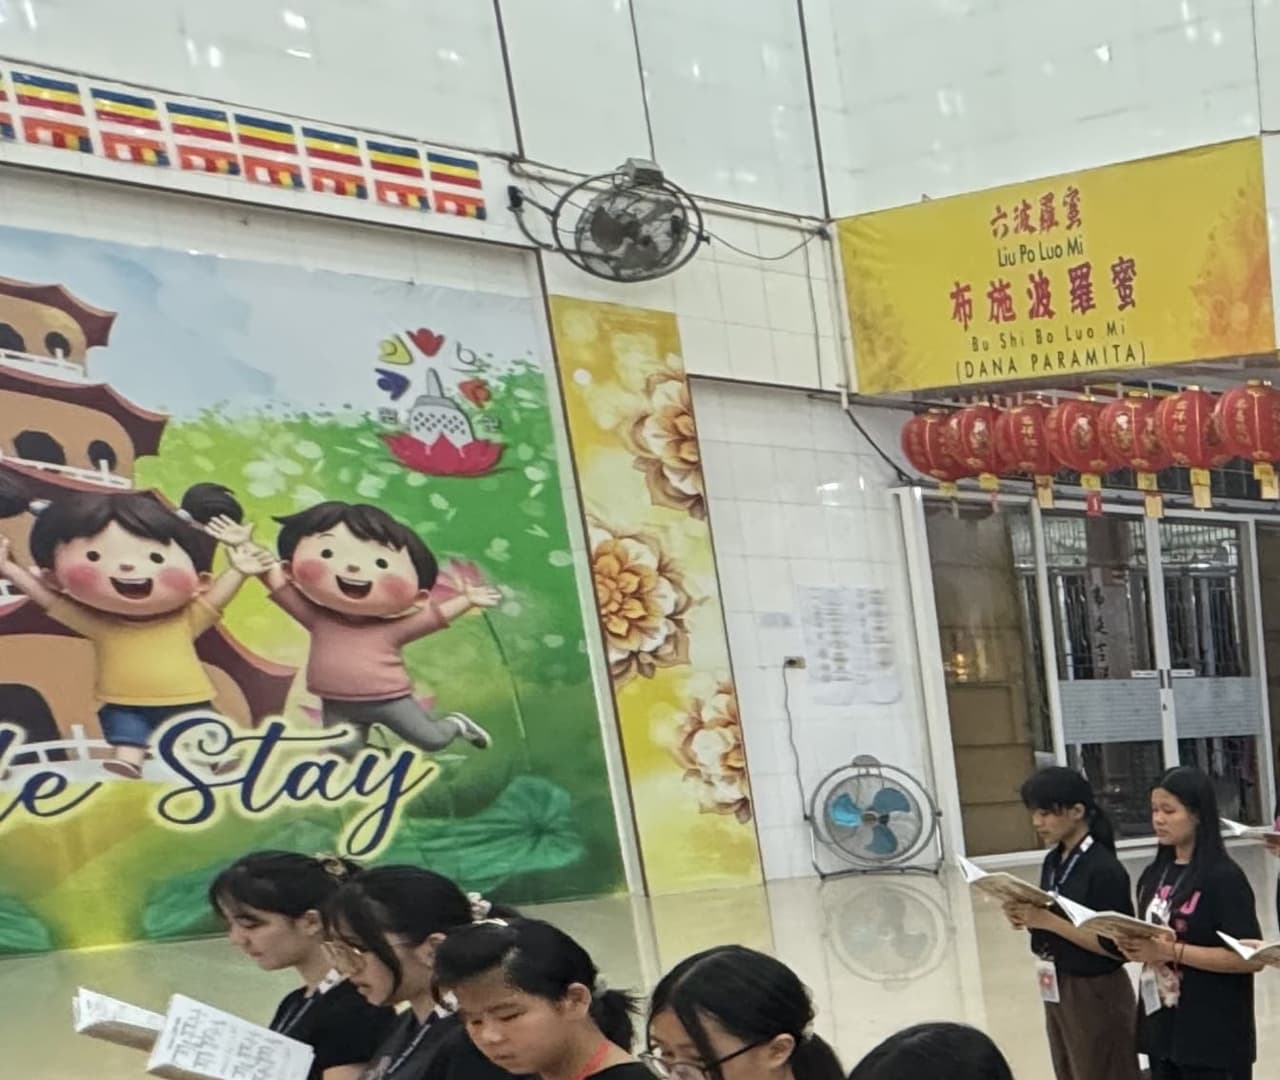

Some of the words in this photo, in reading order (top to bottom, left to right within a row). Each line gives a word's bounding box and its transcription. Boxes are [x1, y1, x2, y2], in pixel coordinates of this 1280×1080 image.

[990, 186, 1082, 239] 六波羅蜜
[998, 246, 1016, 267] Liu
[1020, 244, 1035, 264] Po
[1039, 241, 1063, 261] Luo
[1067, 234, 1084, 257] Mi
[950, 256, 1137, 332] 布施波羅蜜
[972, 336, 989, 352] Bu
[1000, 332, 1024, 349] Shi
[1036, 328, 1054, 345] Bo
[1065, 325, 1094, 341] Luo
[1107, 319, 1125, 337] Mi
[956, 356, 1018, 383] (DANA
[1031, 342, 1146, 371] PARAMITA)
[157, 717, 434, 856] Stay
